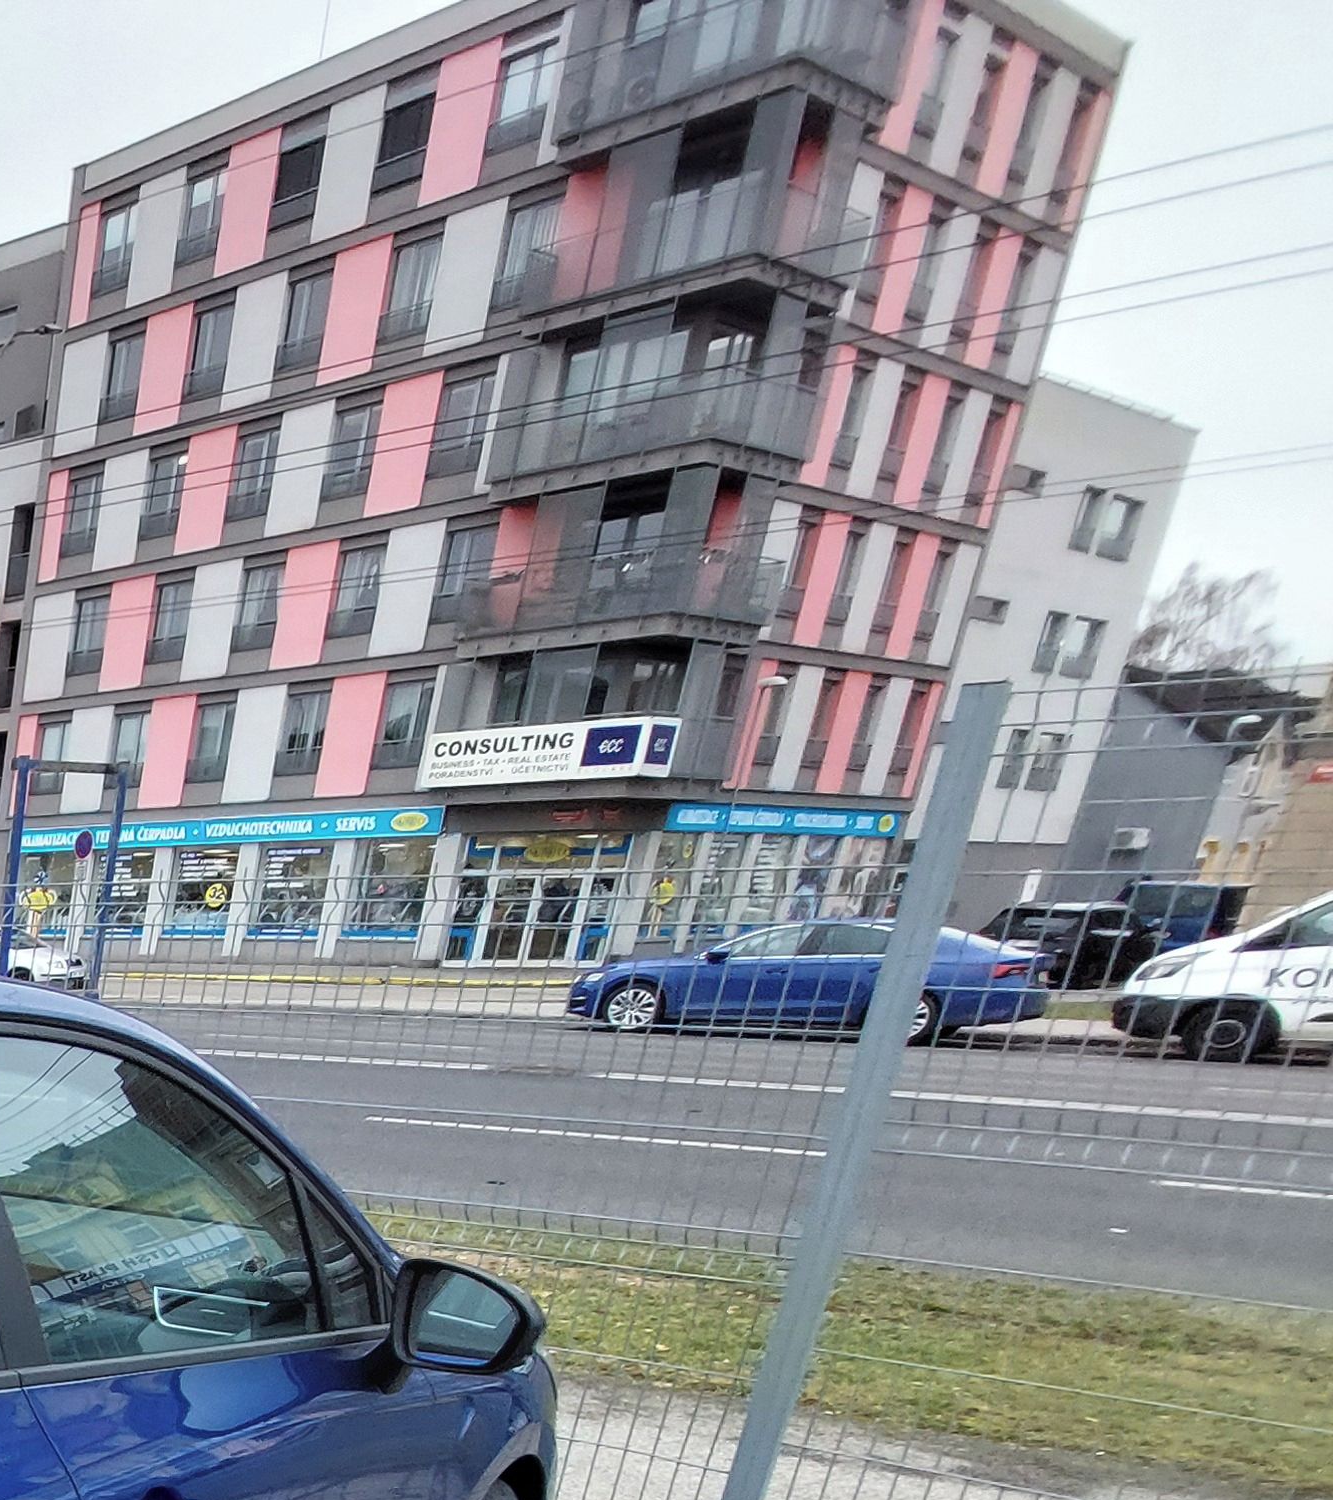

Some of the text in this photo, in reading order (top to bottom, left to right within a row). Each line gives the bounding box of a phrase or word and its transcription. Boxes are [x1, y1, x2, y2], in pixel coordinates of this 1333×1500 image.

[434, 732, 574, 758] CONSULTING
[431, 752, 571, 770] BUSINESS TAX REAL ESTATE
[137, 825, 187, 842] ČERPADLA
[206, 819, 313, 837] VZDUCHOTECHNIKA
[335, 816, 376, 832] SERVIS
